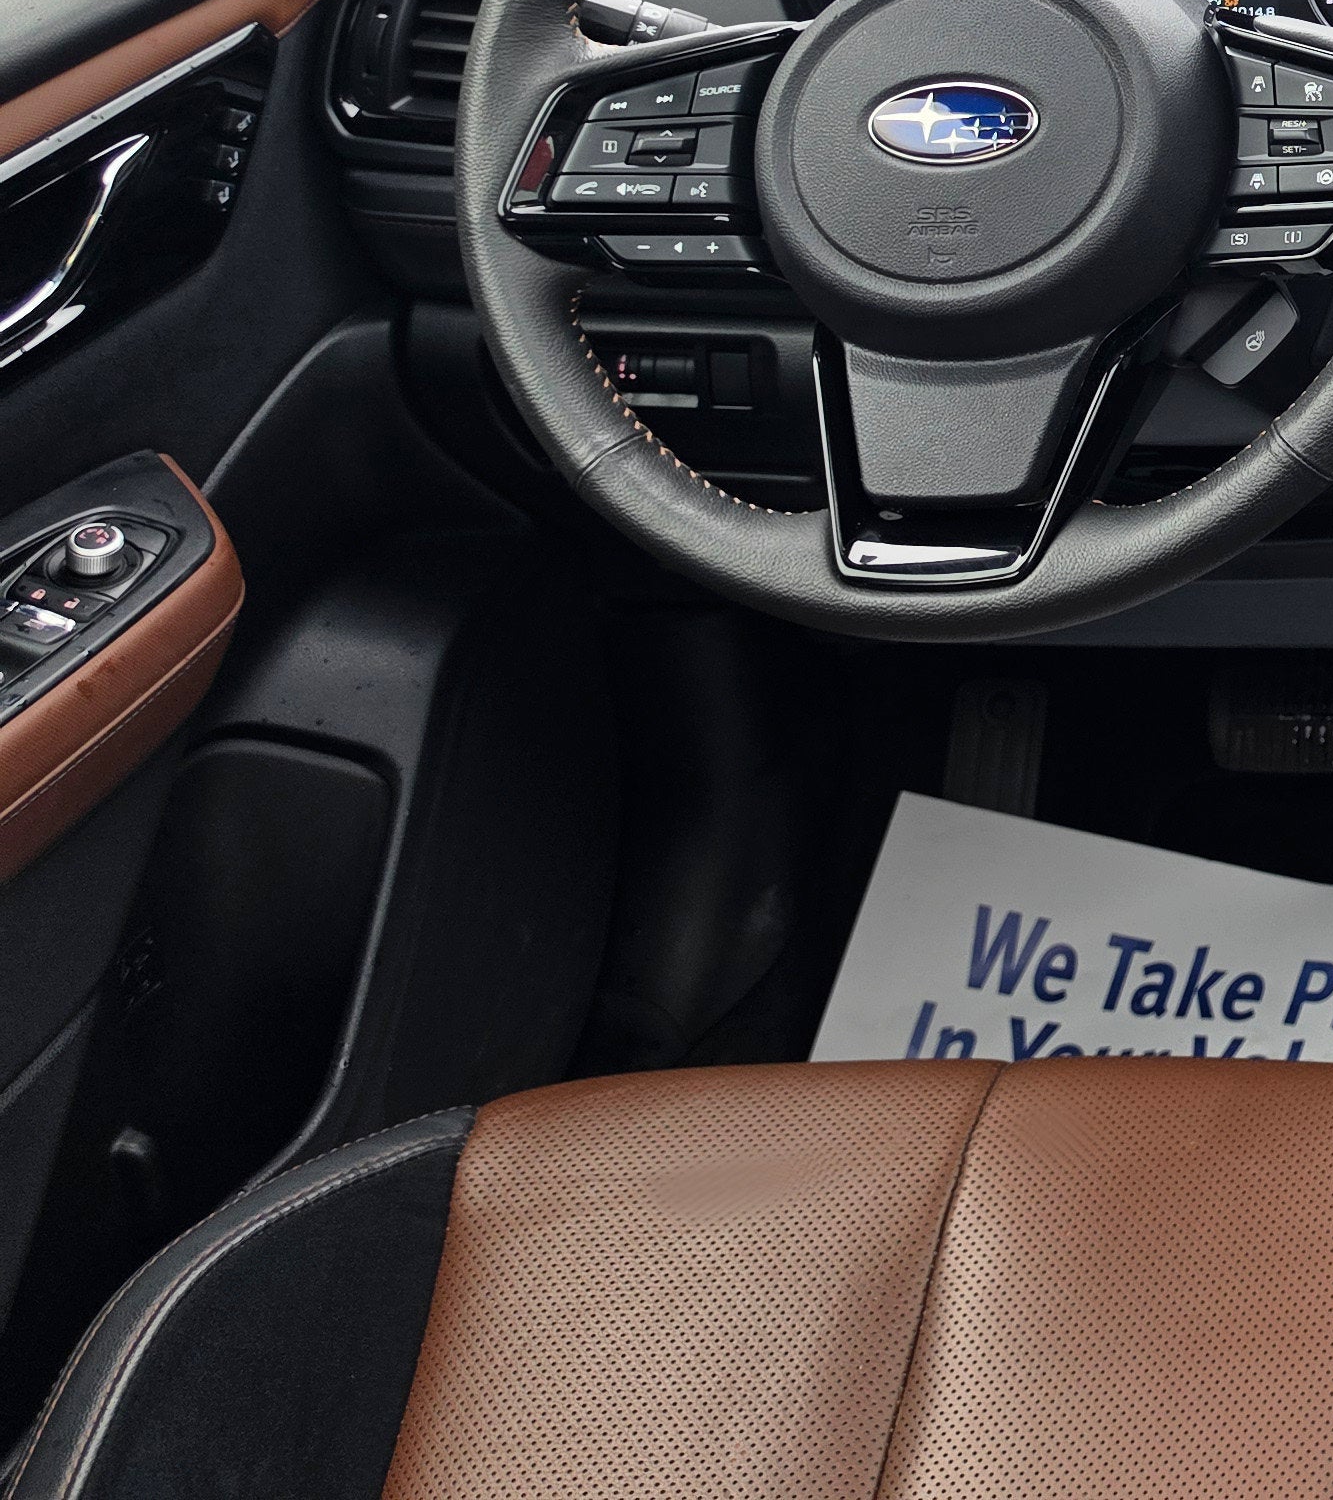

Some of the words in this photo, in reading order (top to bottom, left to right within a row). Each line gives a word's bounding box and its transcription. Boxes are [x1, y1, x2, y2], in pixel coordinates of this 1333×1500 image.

[699, 84, 742, 97] SOURCE
[916, 206, 972, 221] SRS
[907, 224, 980, 236] AIRBAG
[967, 904, 1078, 1002] We
[1100, 933, 1264, 1024] Take
[904, 999, 975, 1061] In
